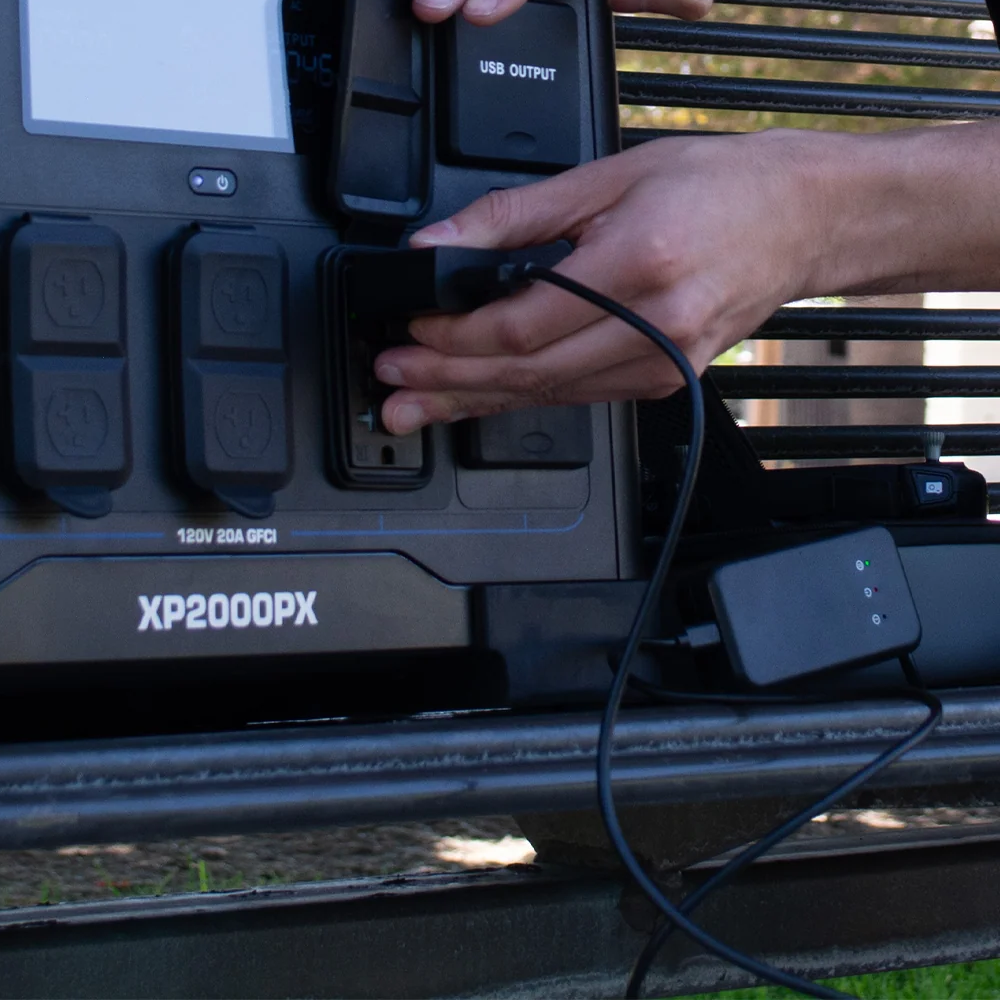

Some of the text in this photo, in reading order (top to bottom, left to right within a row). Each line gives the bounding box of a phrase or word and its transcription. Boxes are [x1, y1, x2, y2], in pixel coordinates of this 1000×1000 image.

[285, 31, 316, 47] TPUT
[480, 60, 556, 81] USB OUTPUT
[177, 528, 277, 544] 120V 20A GFCI
[138, 591, 318, 631] XP2000PX
